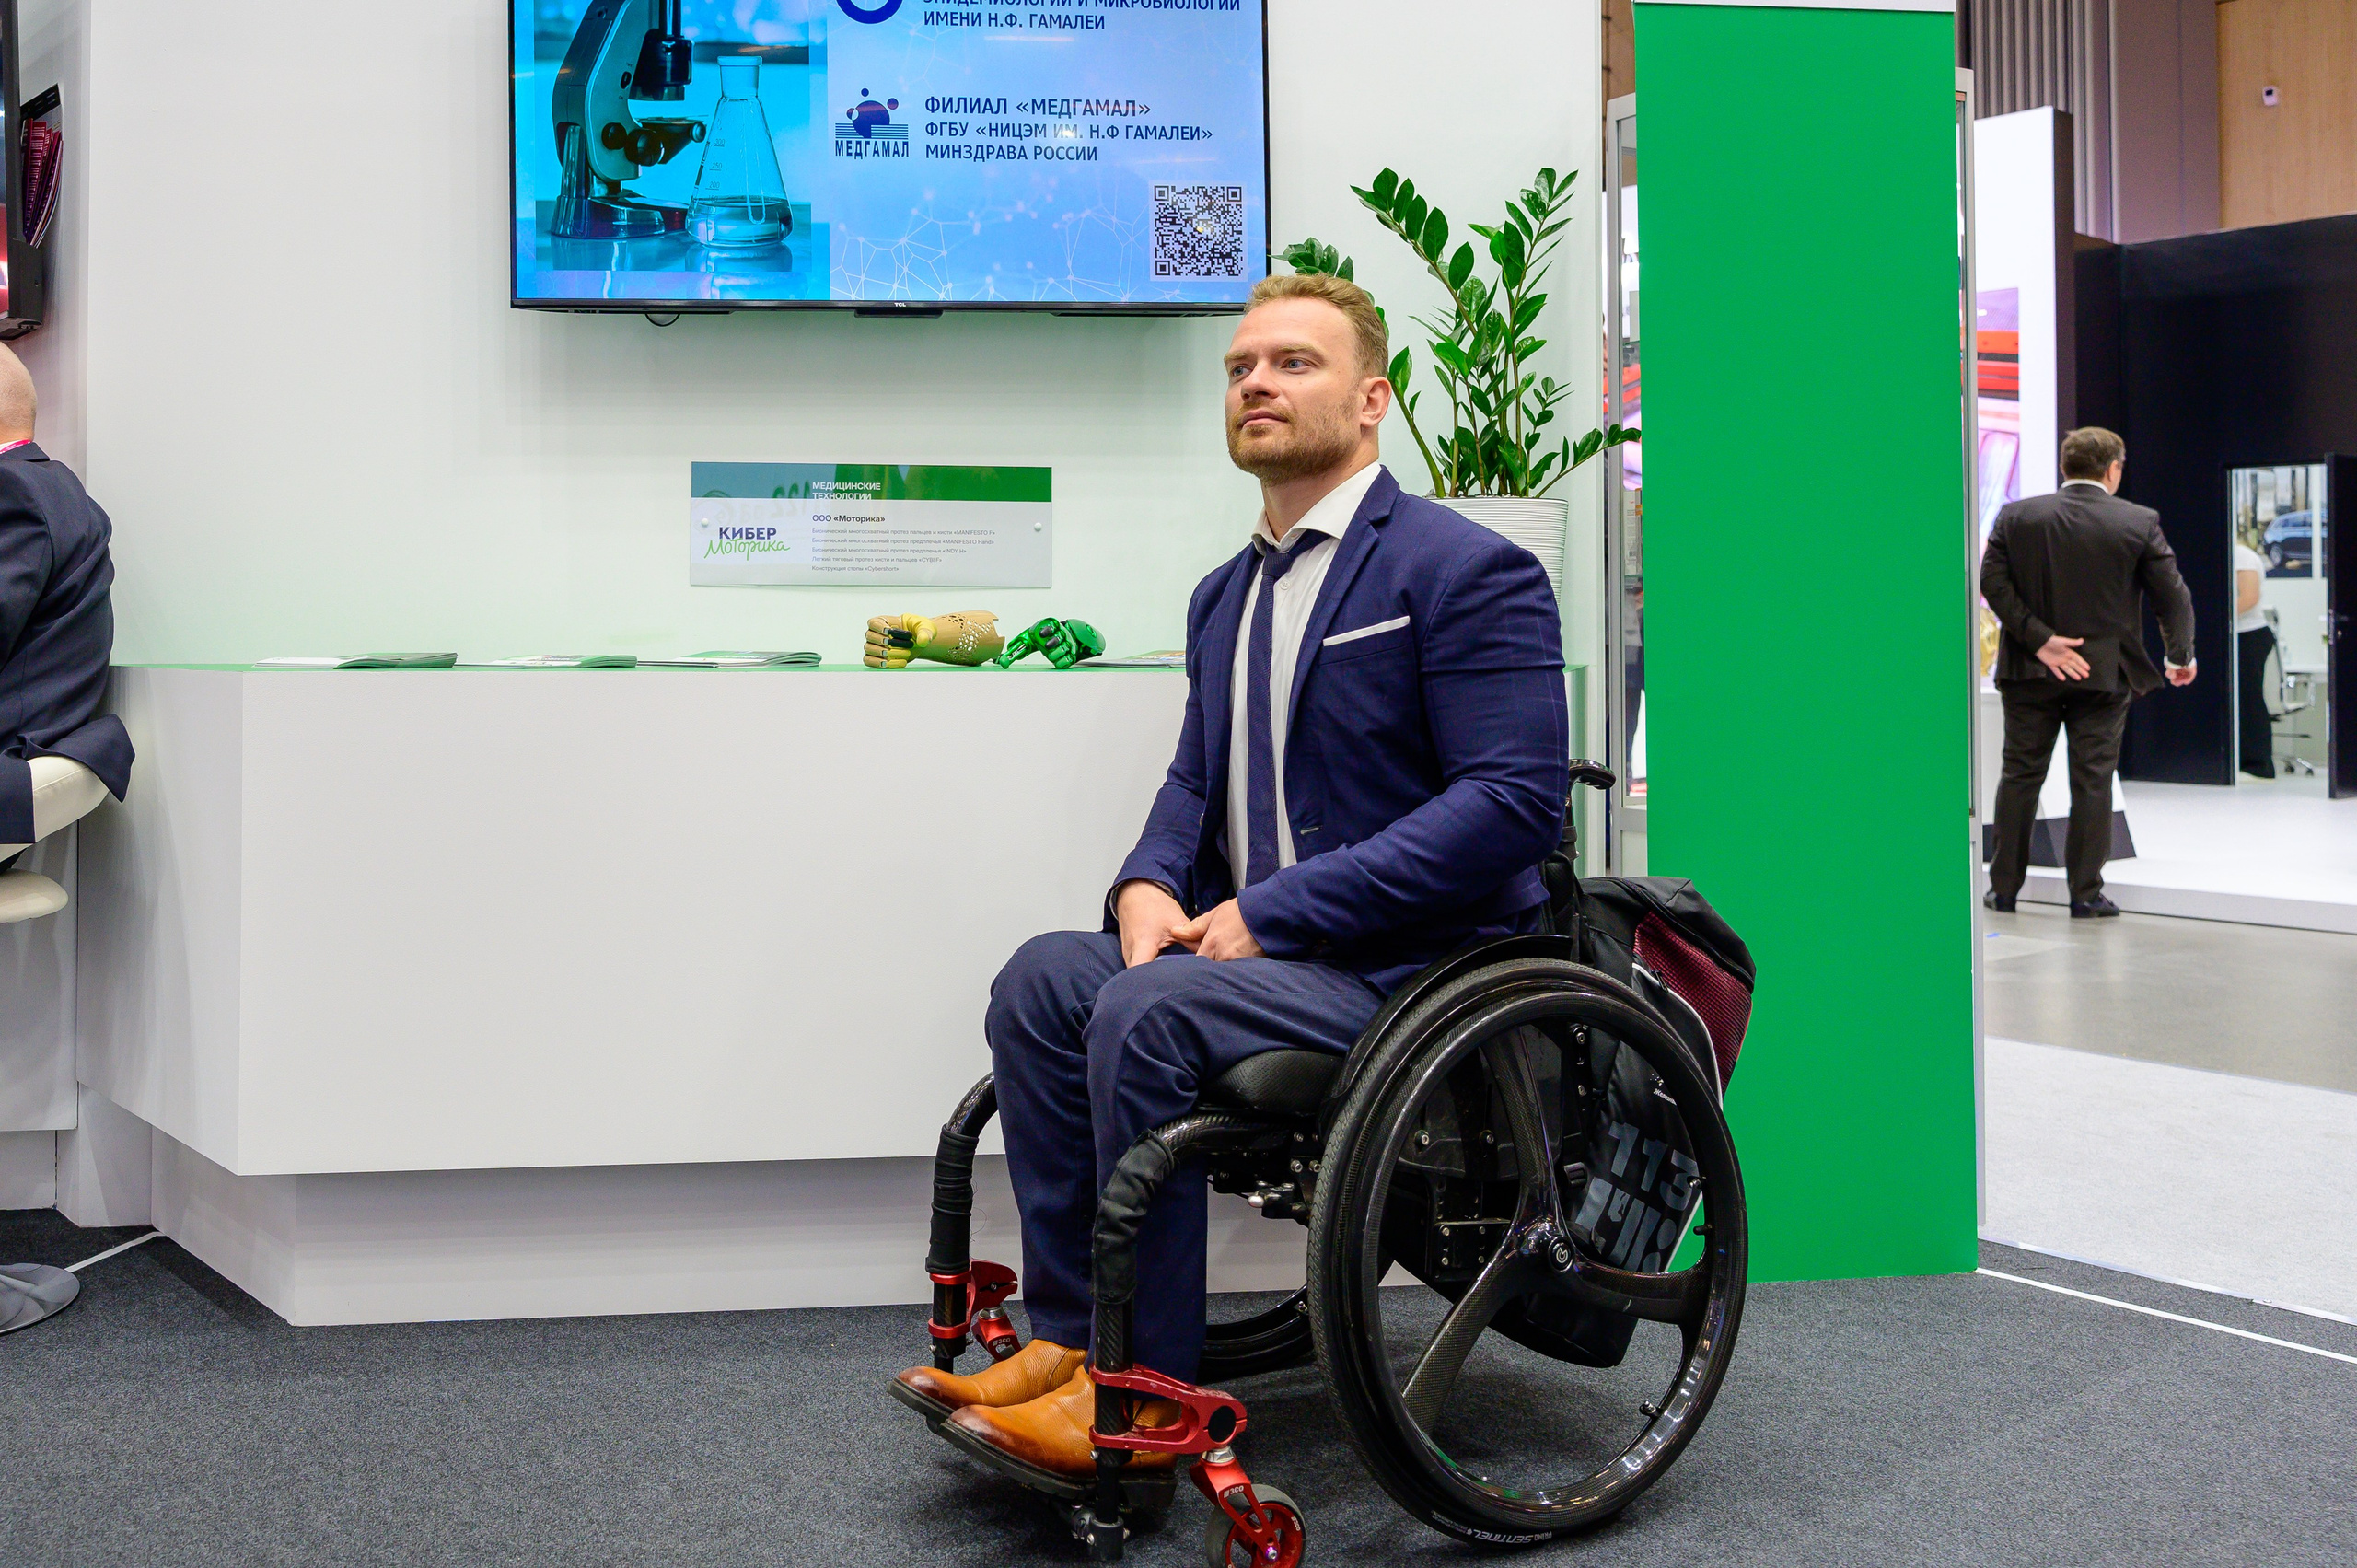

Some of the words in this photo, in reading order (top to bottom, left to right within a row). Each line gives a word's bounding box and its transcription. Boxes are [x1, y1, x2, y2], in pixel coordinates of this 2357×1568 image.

[924, 11, 981, 26] ИМЕНИ
[989, 13, 1022, 27] Н.Ф.
[1029, 14, 1104, 29] ГАМАЛЕИ
[925, 97, 1007, 115] ФИЛИАЛ
[1016, 99, 1151, 119] «МЕДГАМАЛ»
[925, 122, 969, 137] ФГБУ
[976, 122, 1047, 141] «НИЦЭМ
[1053, 124, 1083, 139] ИМ.
[1089, 124, 1119, 140] Н.Ф
[1125, 125, 1213, 141] ГАМАЛЕИ»
[835, 141, 910, 159] МЕДГАМАЛ
[925, 144, 1028, 162] МИНЗДРАВА
[1034, 146, 1097, 161] РОССИИ
[813, 482, 881, 491] МЕДИЦИНСКИЕ
[813, 492, 872, 500] ТЕХНОЛОГИИ
[834, 515, 885, 523] «Моторика»
[719, 527, 777, 540] КИБЕР
[703, 539, 791, 561] Моторика
[1473, 1529, 1534, 1543] SENTINEL
